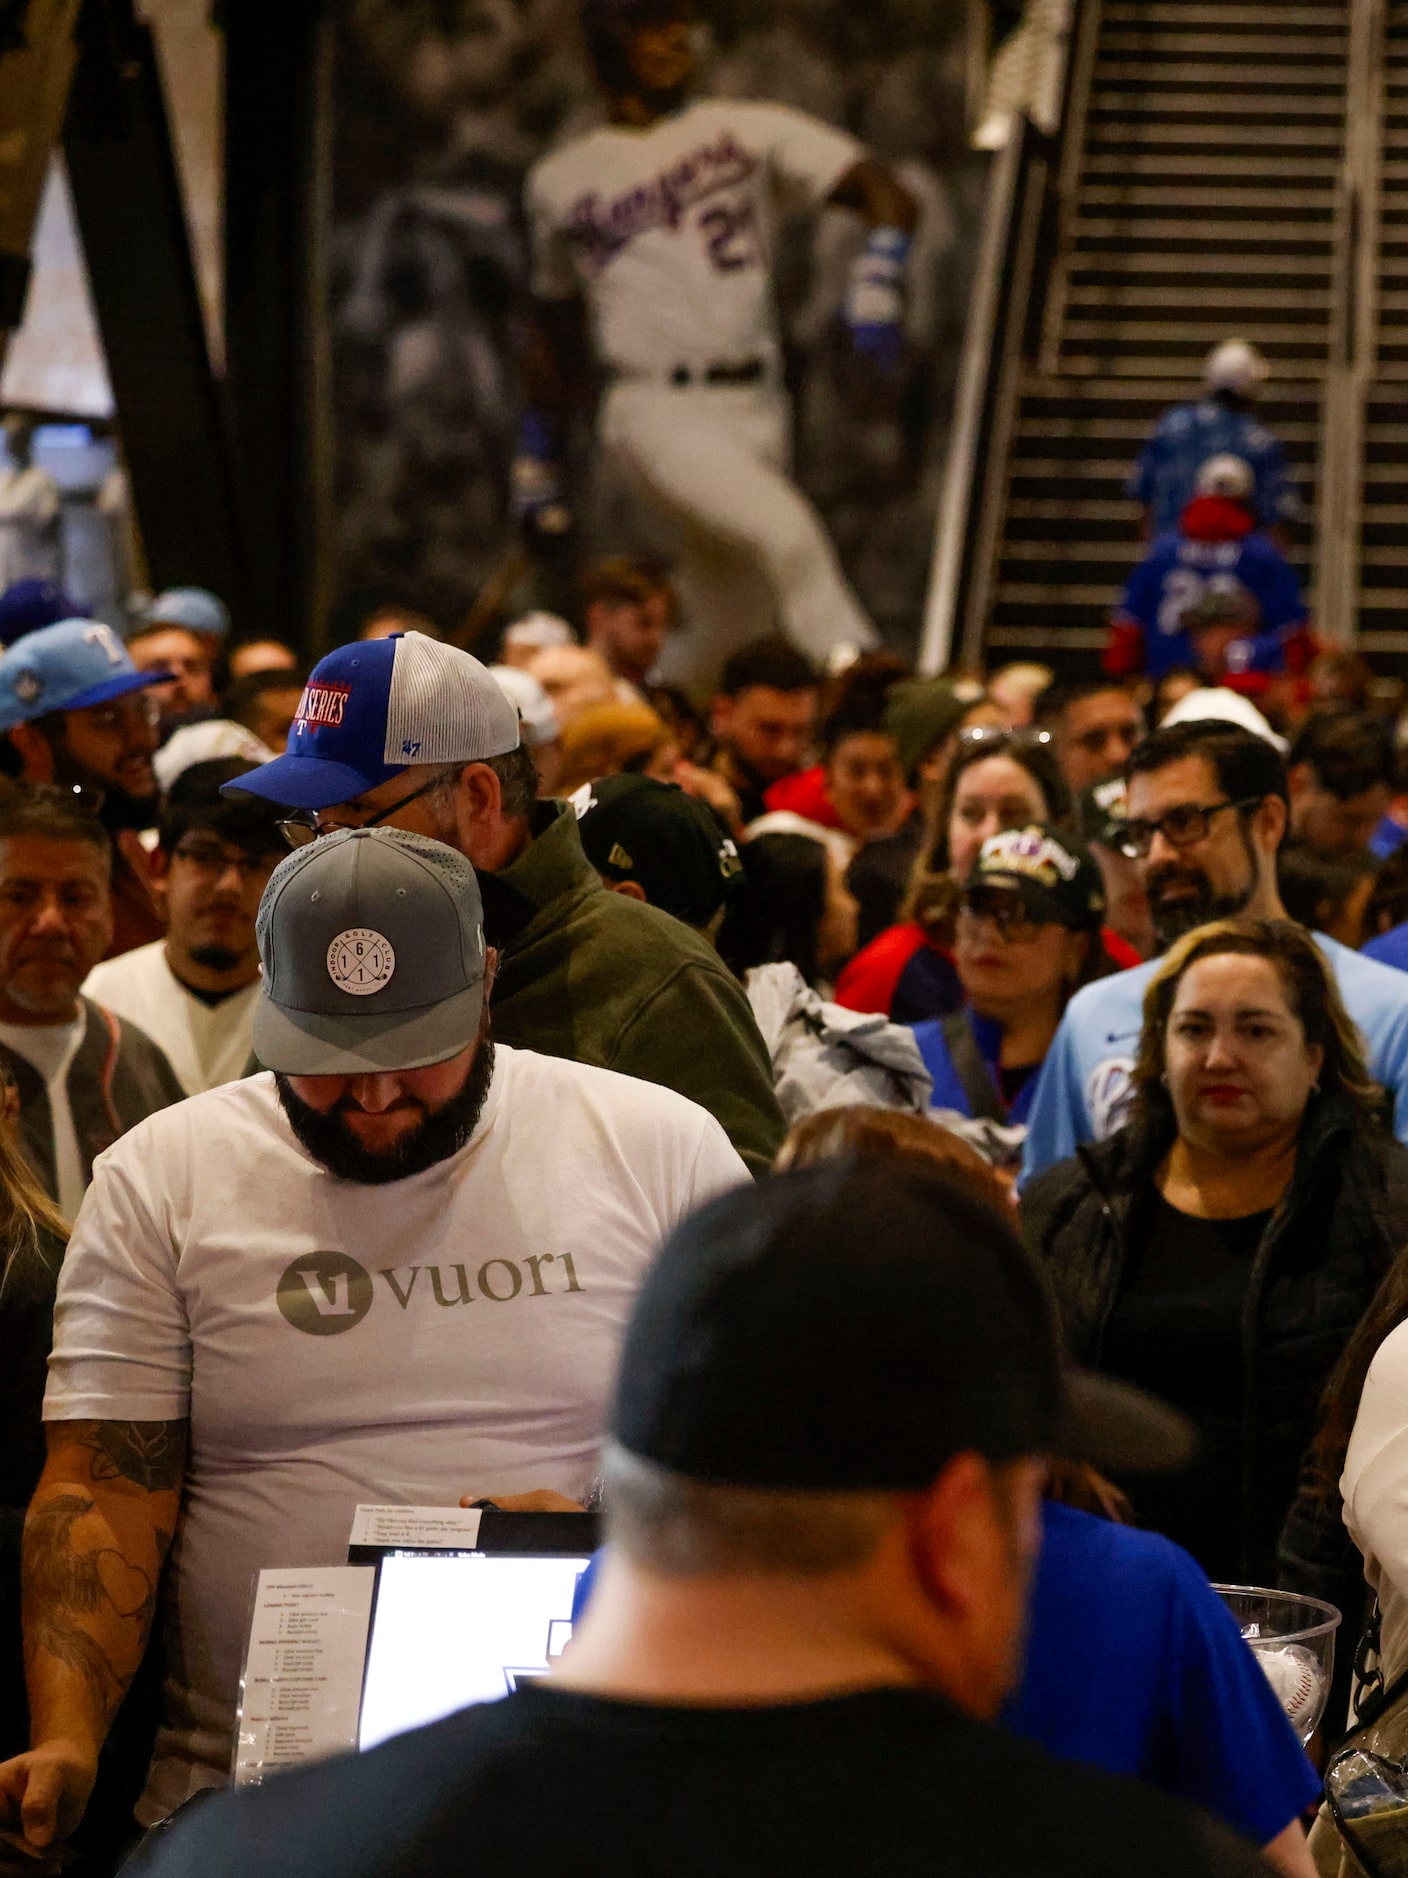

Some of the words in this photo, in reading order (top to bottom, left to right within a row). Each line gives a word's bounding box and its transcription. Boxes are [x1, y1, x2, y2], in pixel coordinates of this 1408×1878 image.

[305, 688, 349, 724] SERIES
[297, 719, 308, 736] T
[345, 931, 373, 939] GOLF
[356, 942, 364, 956] 6
[381, 943, 391, 970] CLUB
[330, 942, 340, 975] INDOOR
[341, 954, 347, 968] 1
[373, 954, 378, 968] 1
[357, 968, 363, 982] 1
[377, 1252, 586, 1310] vuori
